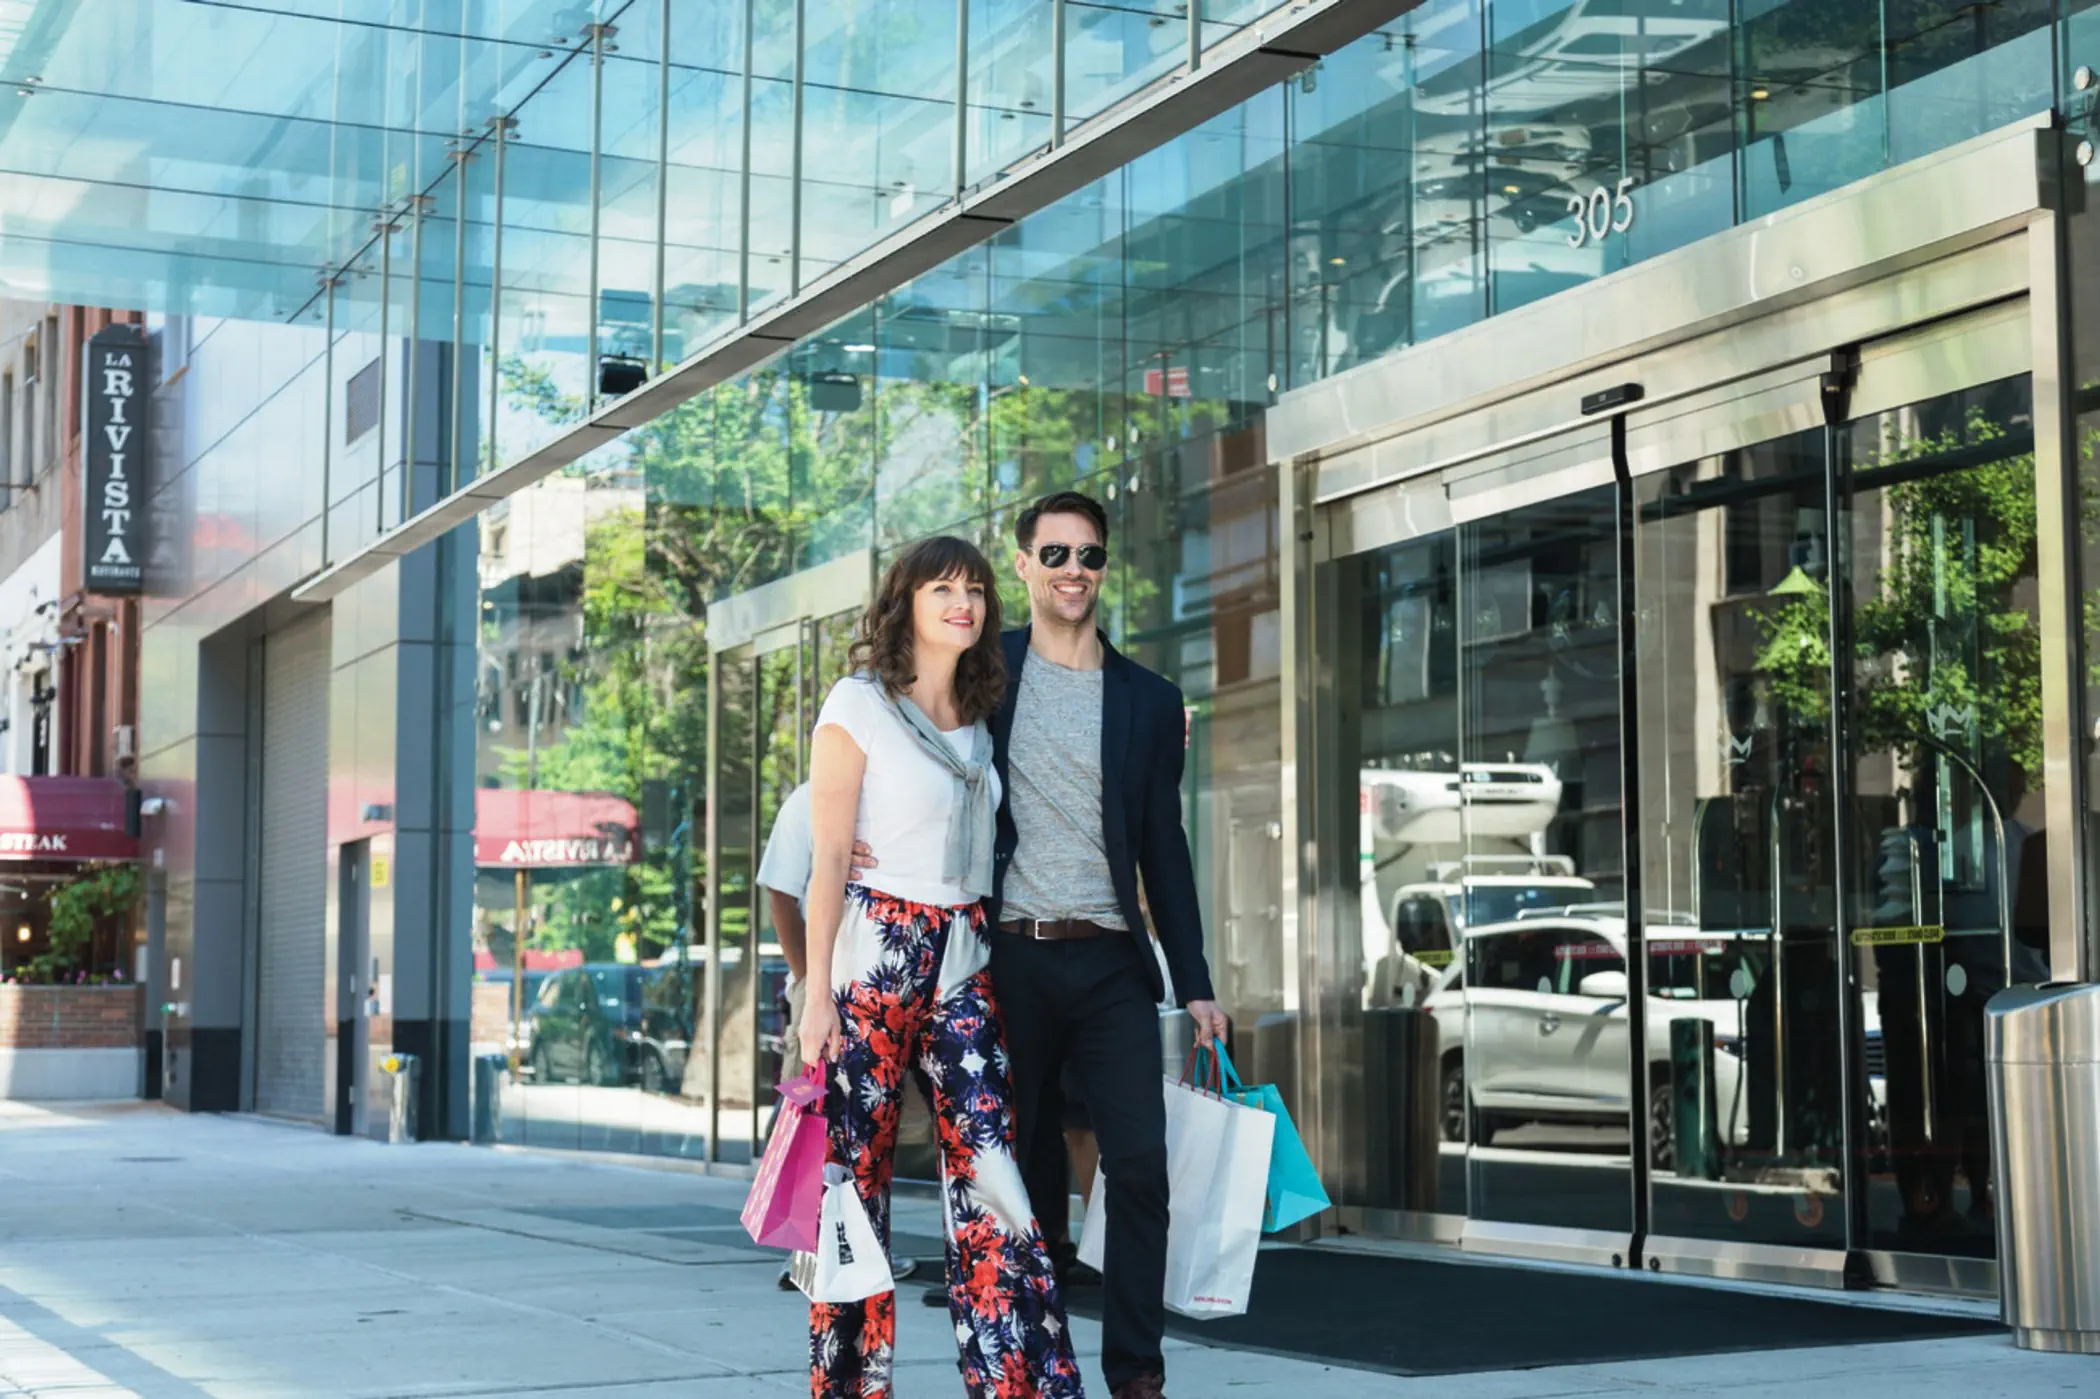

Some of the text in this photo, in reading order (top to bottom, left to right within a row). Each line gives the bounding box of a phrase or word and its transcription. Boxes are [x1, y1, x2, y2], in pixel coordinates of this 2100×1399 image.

[1567, 176, 1633, 249] 305
[104, 352, 132, 366] LA
[101, 369, 134, 563] RIVISTA
[0, 832, 67, 852] STEAK
